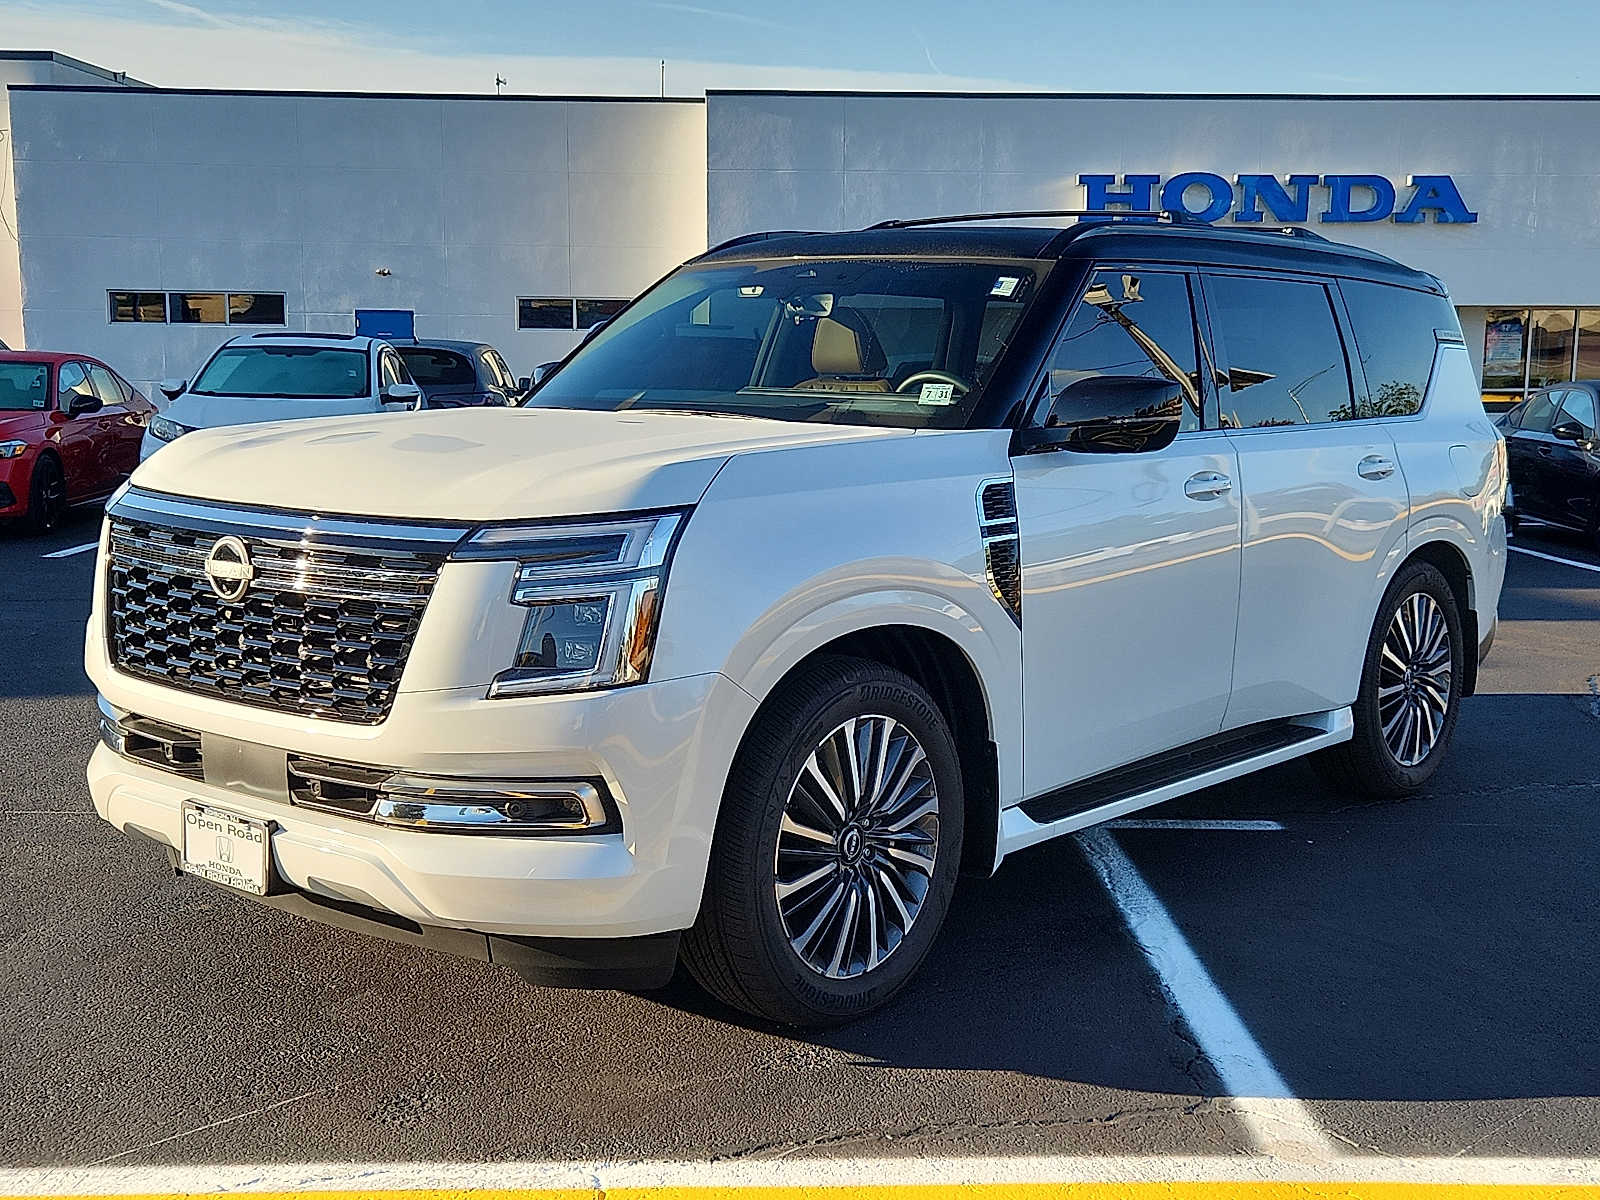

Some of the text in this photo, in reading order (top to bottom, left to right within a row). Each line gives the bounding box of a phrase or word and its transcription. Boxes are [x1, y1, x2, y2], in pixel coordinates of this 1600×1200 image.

[1077, 171, 1478, 224] HONDA
[926, 390, 949, 399] 7 31
[206, 560, 250, 579] NIAN
[860, 684, 937, 729] BRIDGESTONE
[187, 814, 262, 843] Open Road
[208, 860, 243, 877] HONDA
[207, 871, 230, 884] ROAD
[231, 878, 261, 894] HONDA
